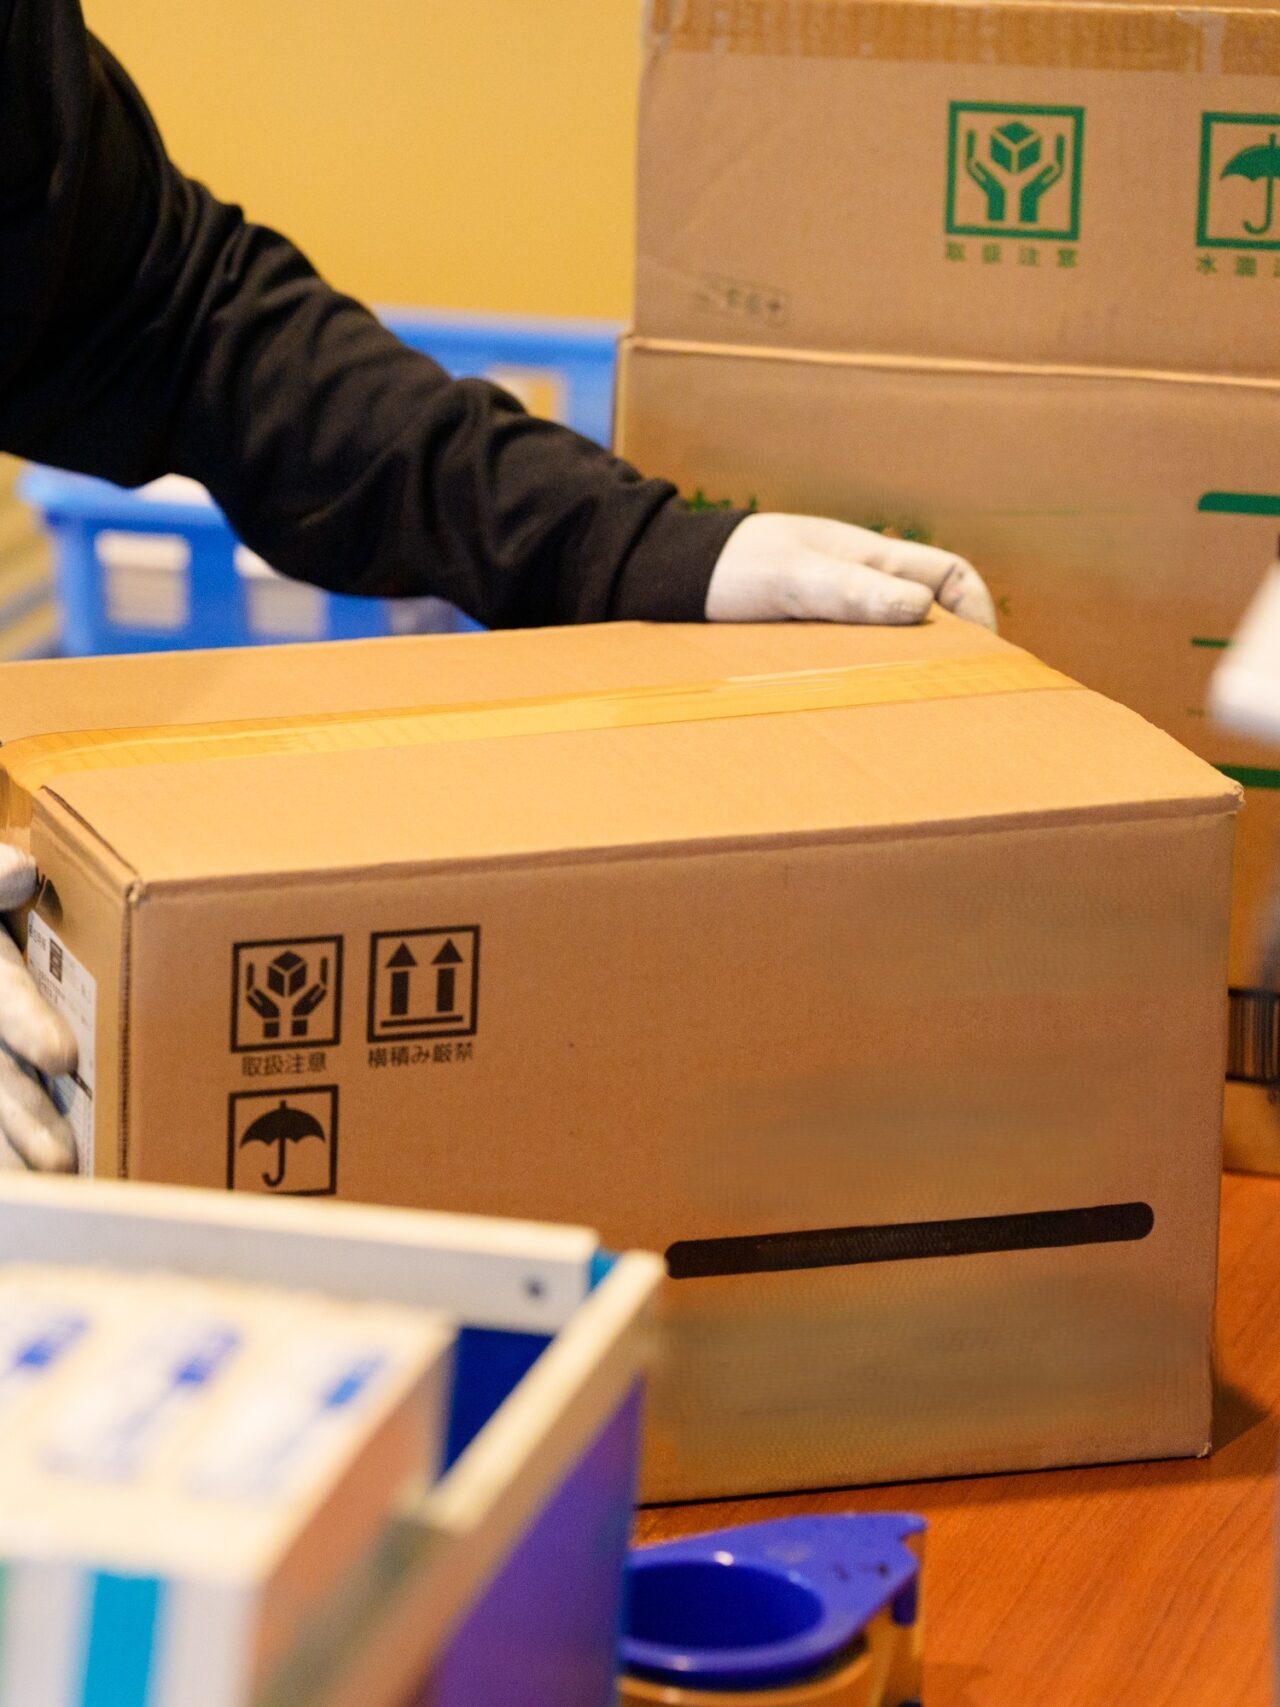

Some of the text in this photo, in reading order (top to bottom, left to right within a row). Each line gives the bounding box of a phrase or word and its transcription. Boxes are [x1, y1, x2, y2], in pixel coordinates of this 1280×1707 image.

[241, 1052, 327, 1077] 取扱注意
[368, 1042, 475, 1070] 横積み厳禁
